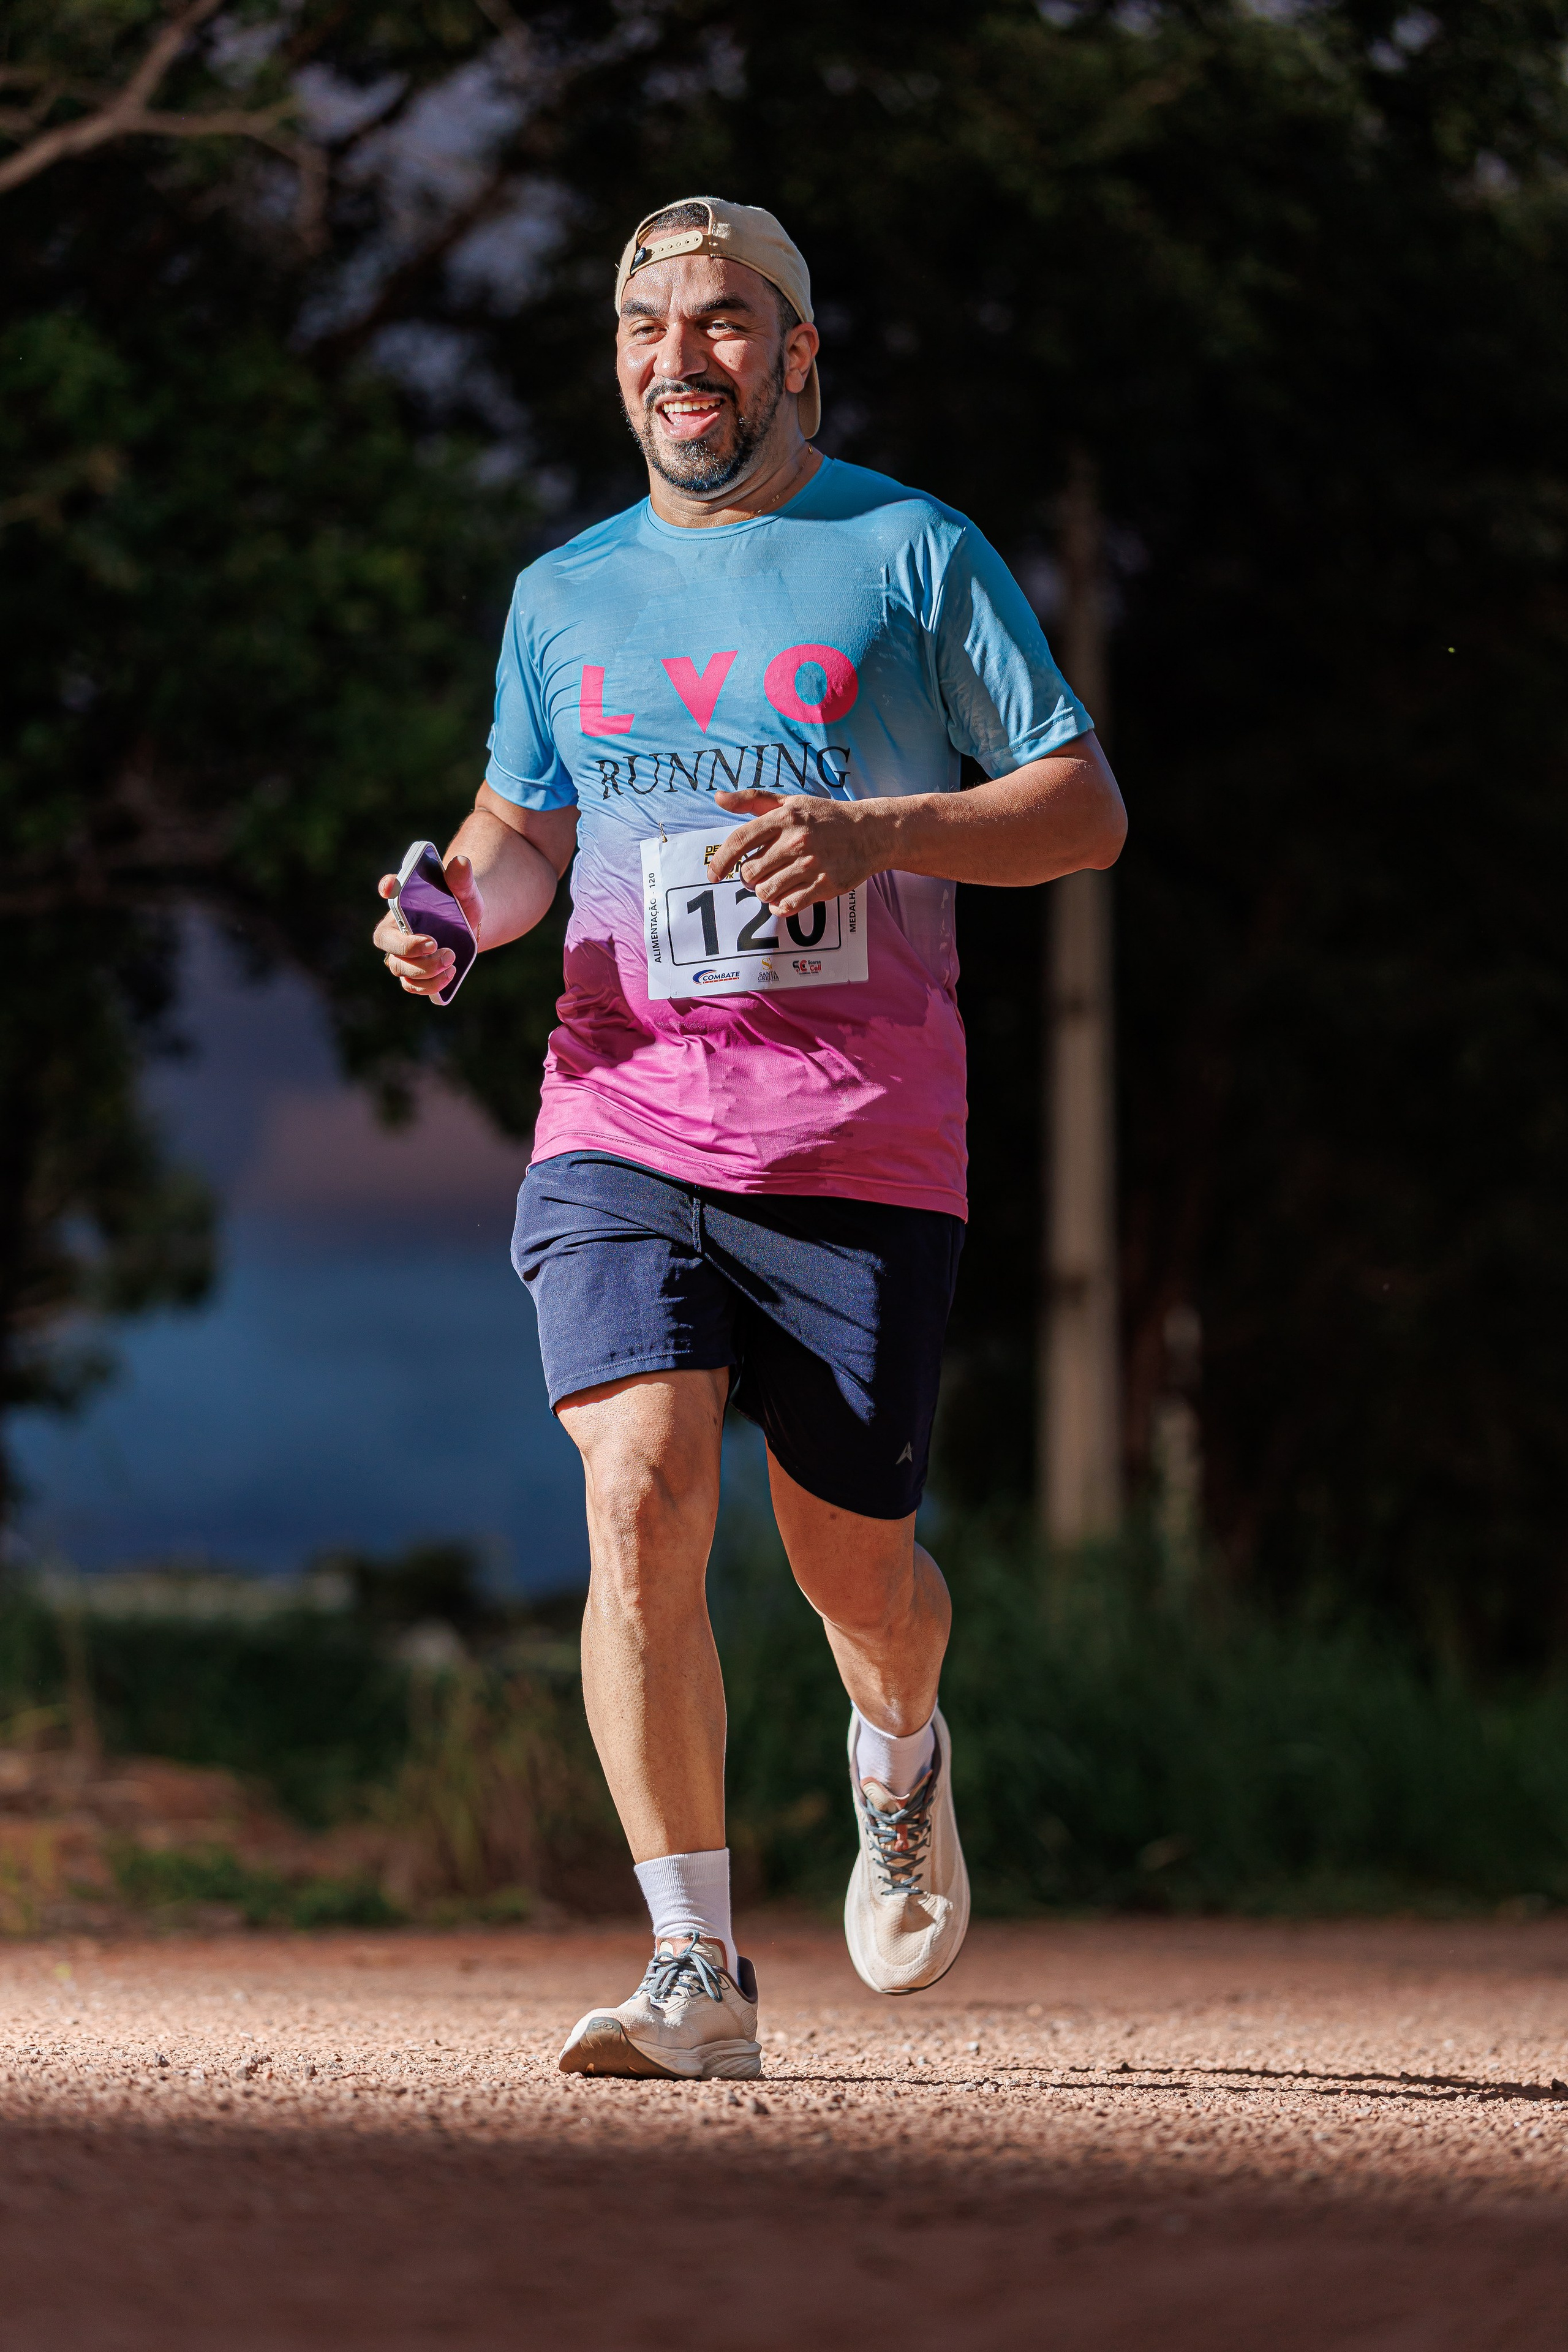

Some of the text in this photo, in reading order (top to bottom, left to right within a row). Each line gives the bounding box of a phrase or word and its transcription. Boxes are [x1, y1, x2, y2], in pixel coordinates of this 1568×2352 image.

[579, 644, 858, 737] LVO
[595, 742, 851, 800] RUNNING
[649, 898, 662, 963] ALIMENTAÇÃO
[687, 888, 826, 956] 120
[703, 971, 740, 981] COMBATE
